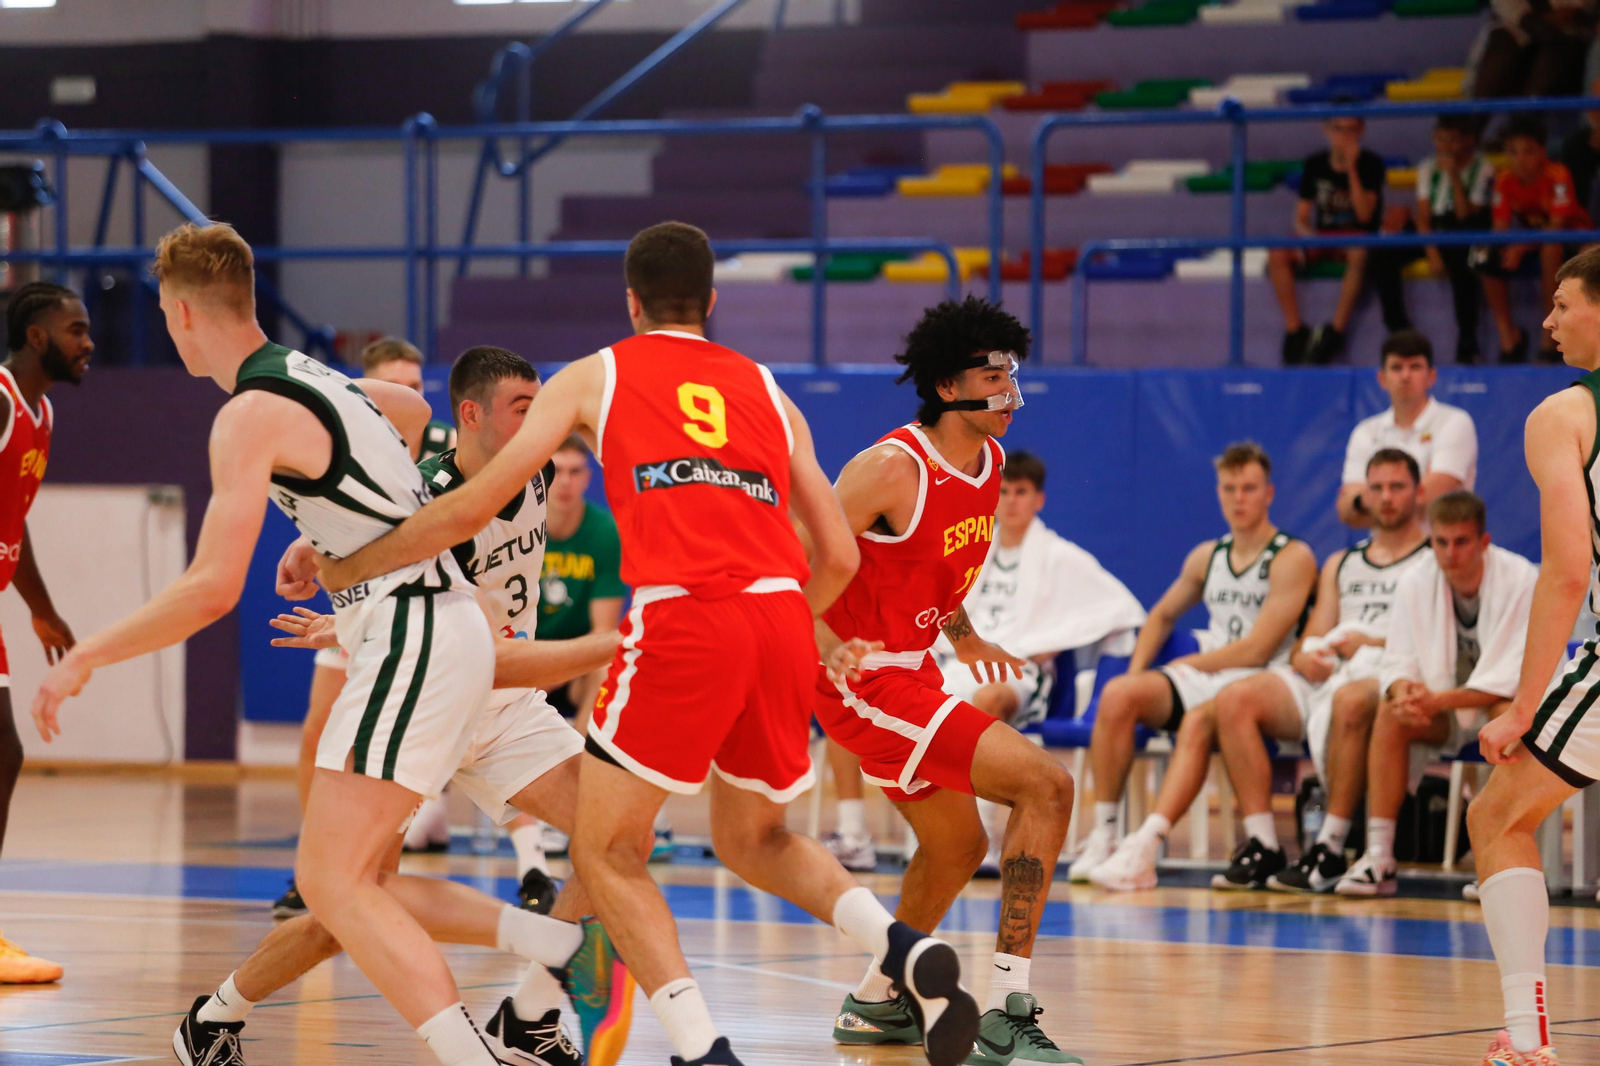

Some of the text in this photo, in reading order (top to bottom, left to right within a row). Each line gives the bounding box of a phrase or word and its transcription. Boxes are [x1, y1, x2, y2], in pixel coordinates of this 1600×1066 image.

[677, 382, 729, 448] 9
[469, 519, 547, 577] LIETUV
[505, 573, 527, 618] 3
